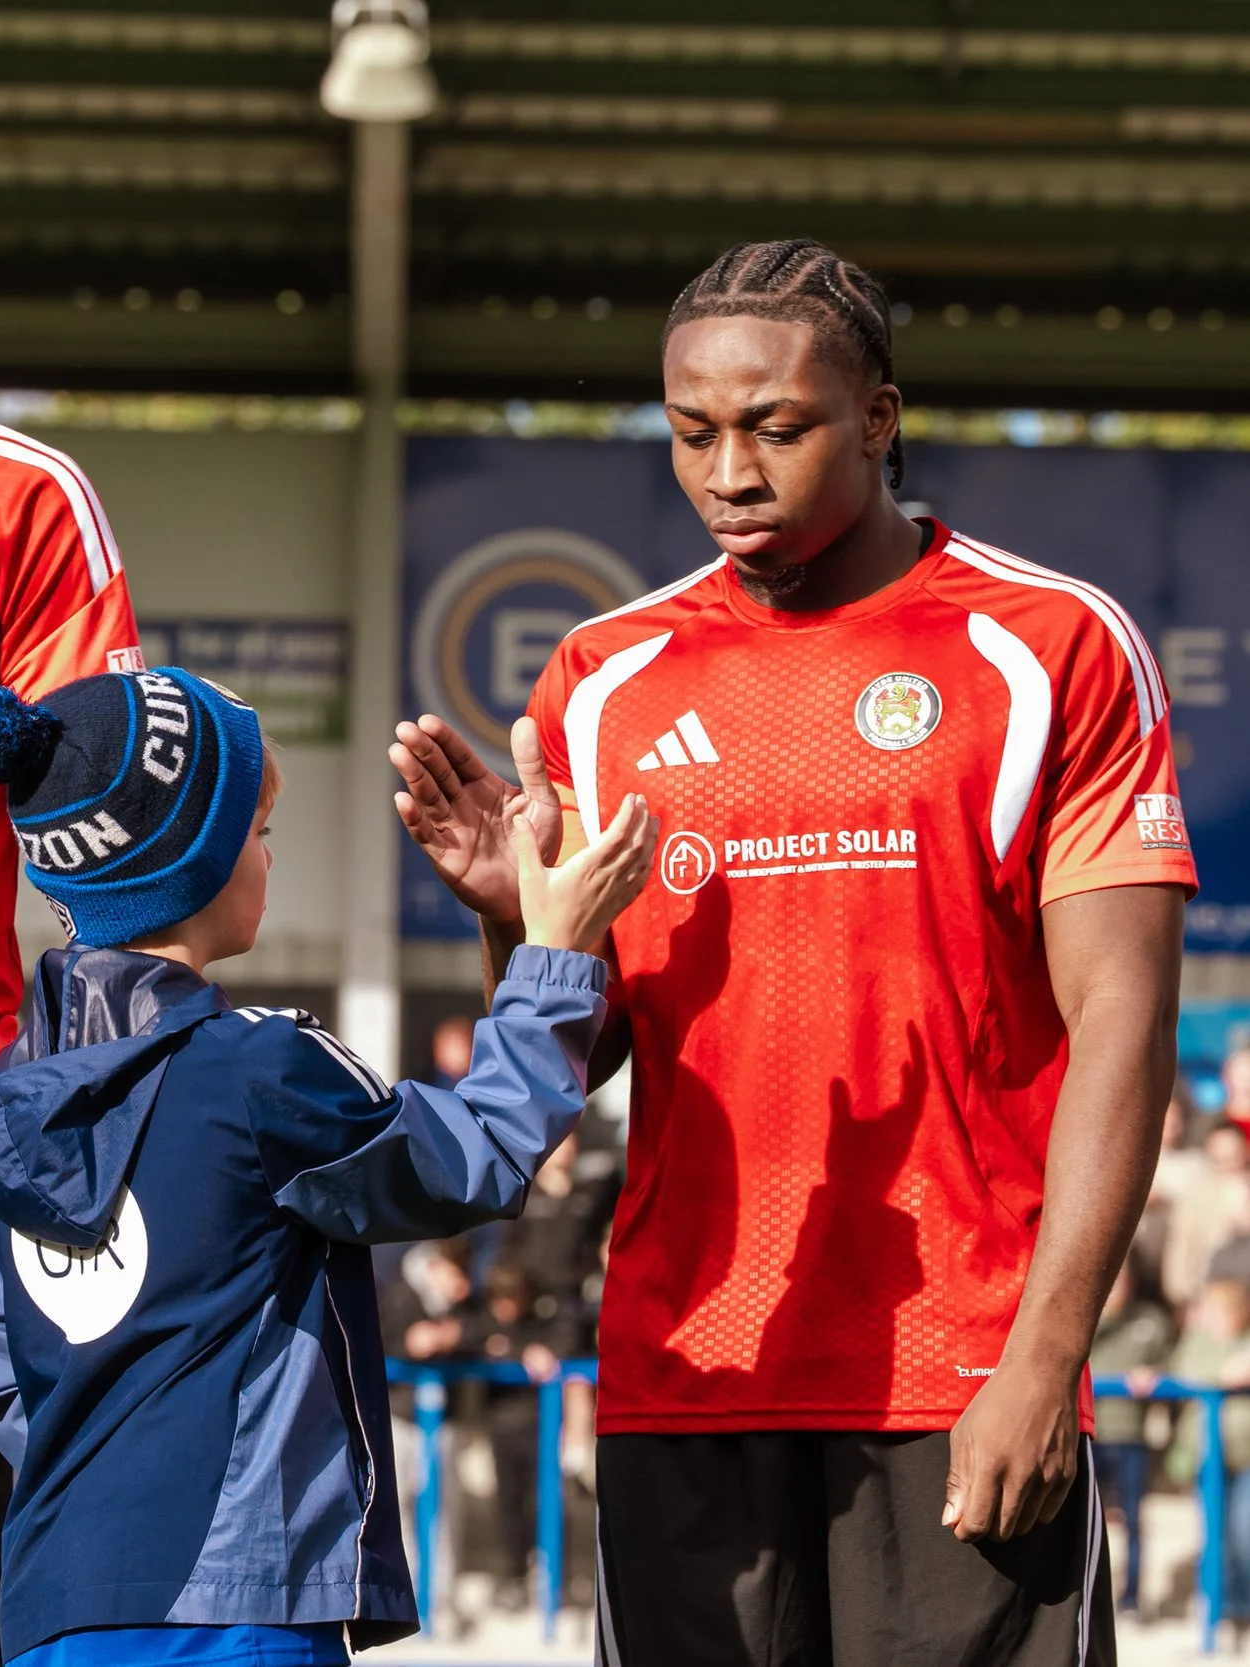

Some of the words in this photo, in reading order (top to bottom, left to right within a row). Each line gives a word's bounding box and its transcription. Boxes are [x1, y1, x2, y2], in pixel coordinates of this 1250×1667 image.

[136, 673, 188, 784] CUR
[1138, 798, 1153, 816] T
[1165, 798, 1174, 816] &
[14, 810, 132, 870] ZON
[725, 832, 829, 863] PROJECT
[837, 829, 917, 854] SOLAR
